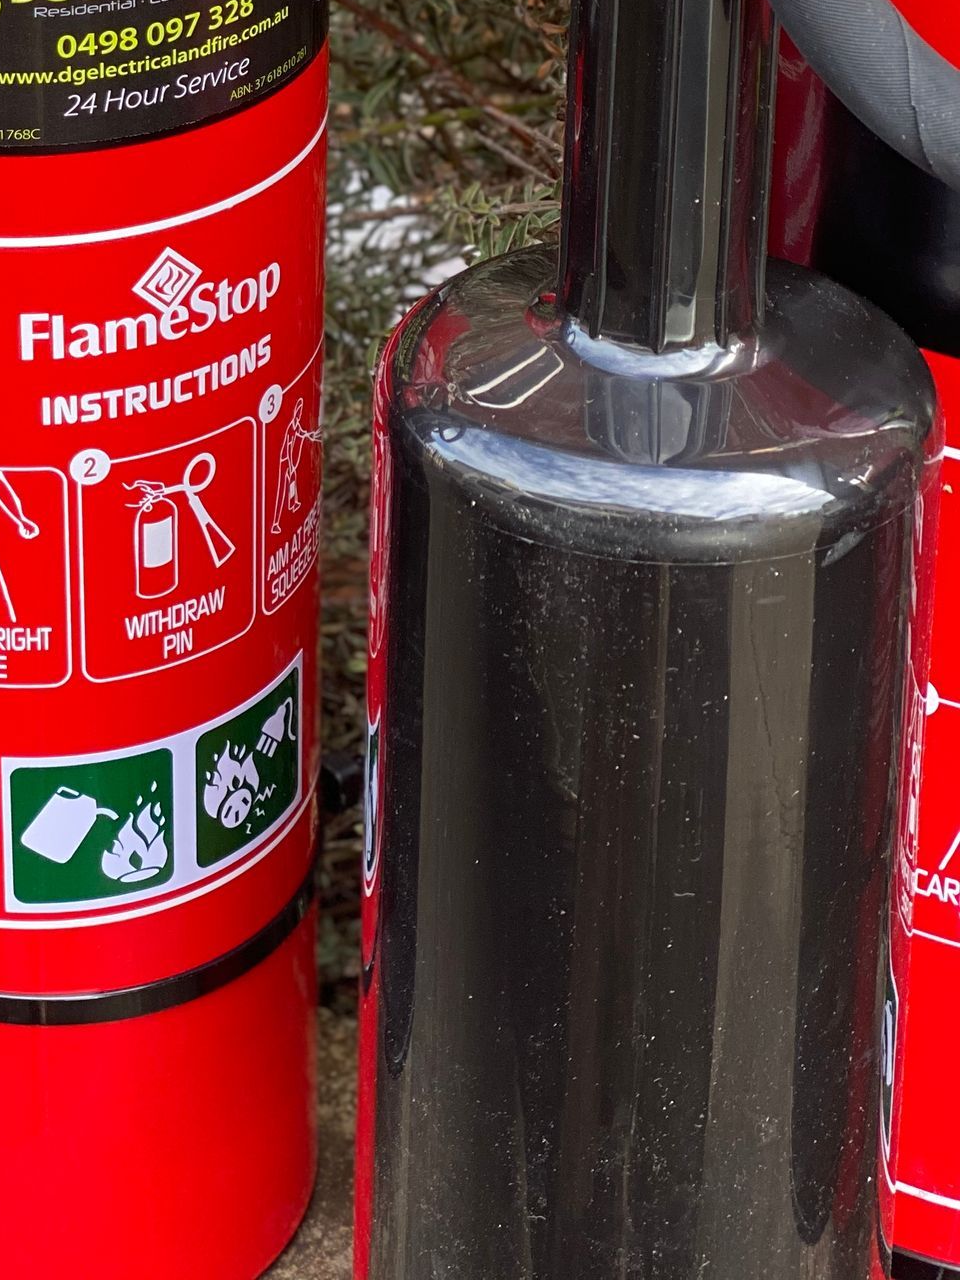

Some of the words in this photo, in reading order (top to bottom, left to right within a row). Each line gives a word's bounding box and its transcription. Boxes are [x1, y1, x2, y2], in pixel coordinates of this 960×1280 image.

[57, 27, 138, 59] 0498
[146, 12, 200, 47] 097
[63, 95, 97, 118] 24
[105, 85, 166, 112] Hour
[174, 57, 250, 99] Service
[230, 83, 253, 101] ABN:
[255, 76, 265, 89] 37
[268, 66, 282, 82] 618
[283, 56, 295, 72] 610
[19, 261, 281, 362] FlameStop
[42, 333, 272, 426] INSTRUCTIONS
[266, 395, 276, 415] 3
[84, 458, 97, 478] 2
[267, 541, 289, 581] AIM
[290, 526, 303, 559] AT
[271, 537, 312, 604] SQUEEZE
[124, 585, 226, 642] WITHDRAW
[163, 638, 193, 659] PIN
[914, 869, 960, 905] CAR
